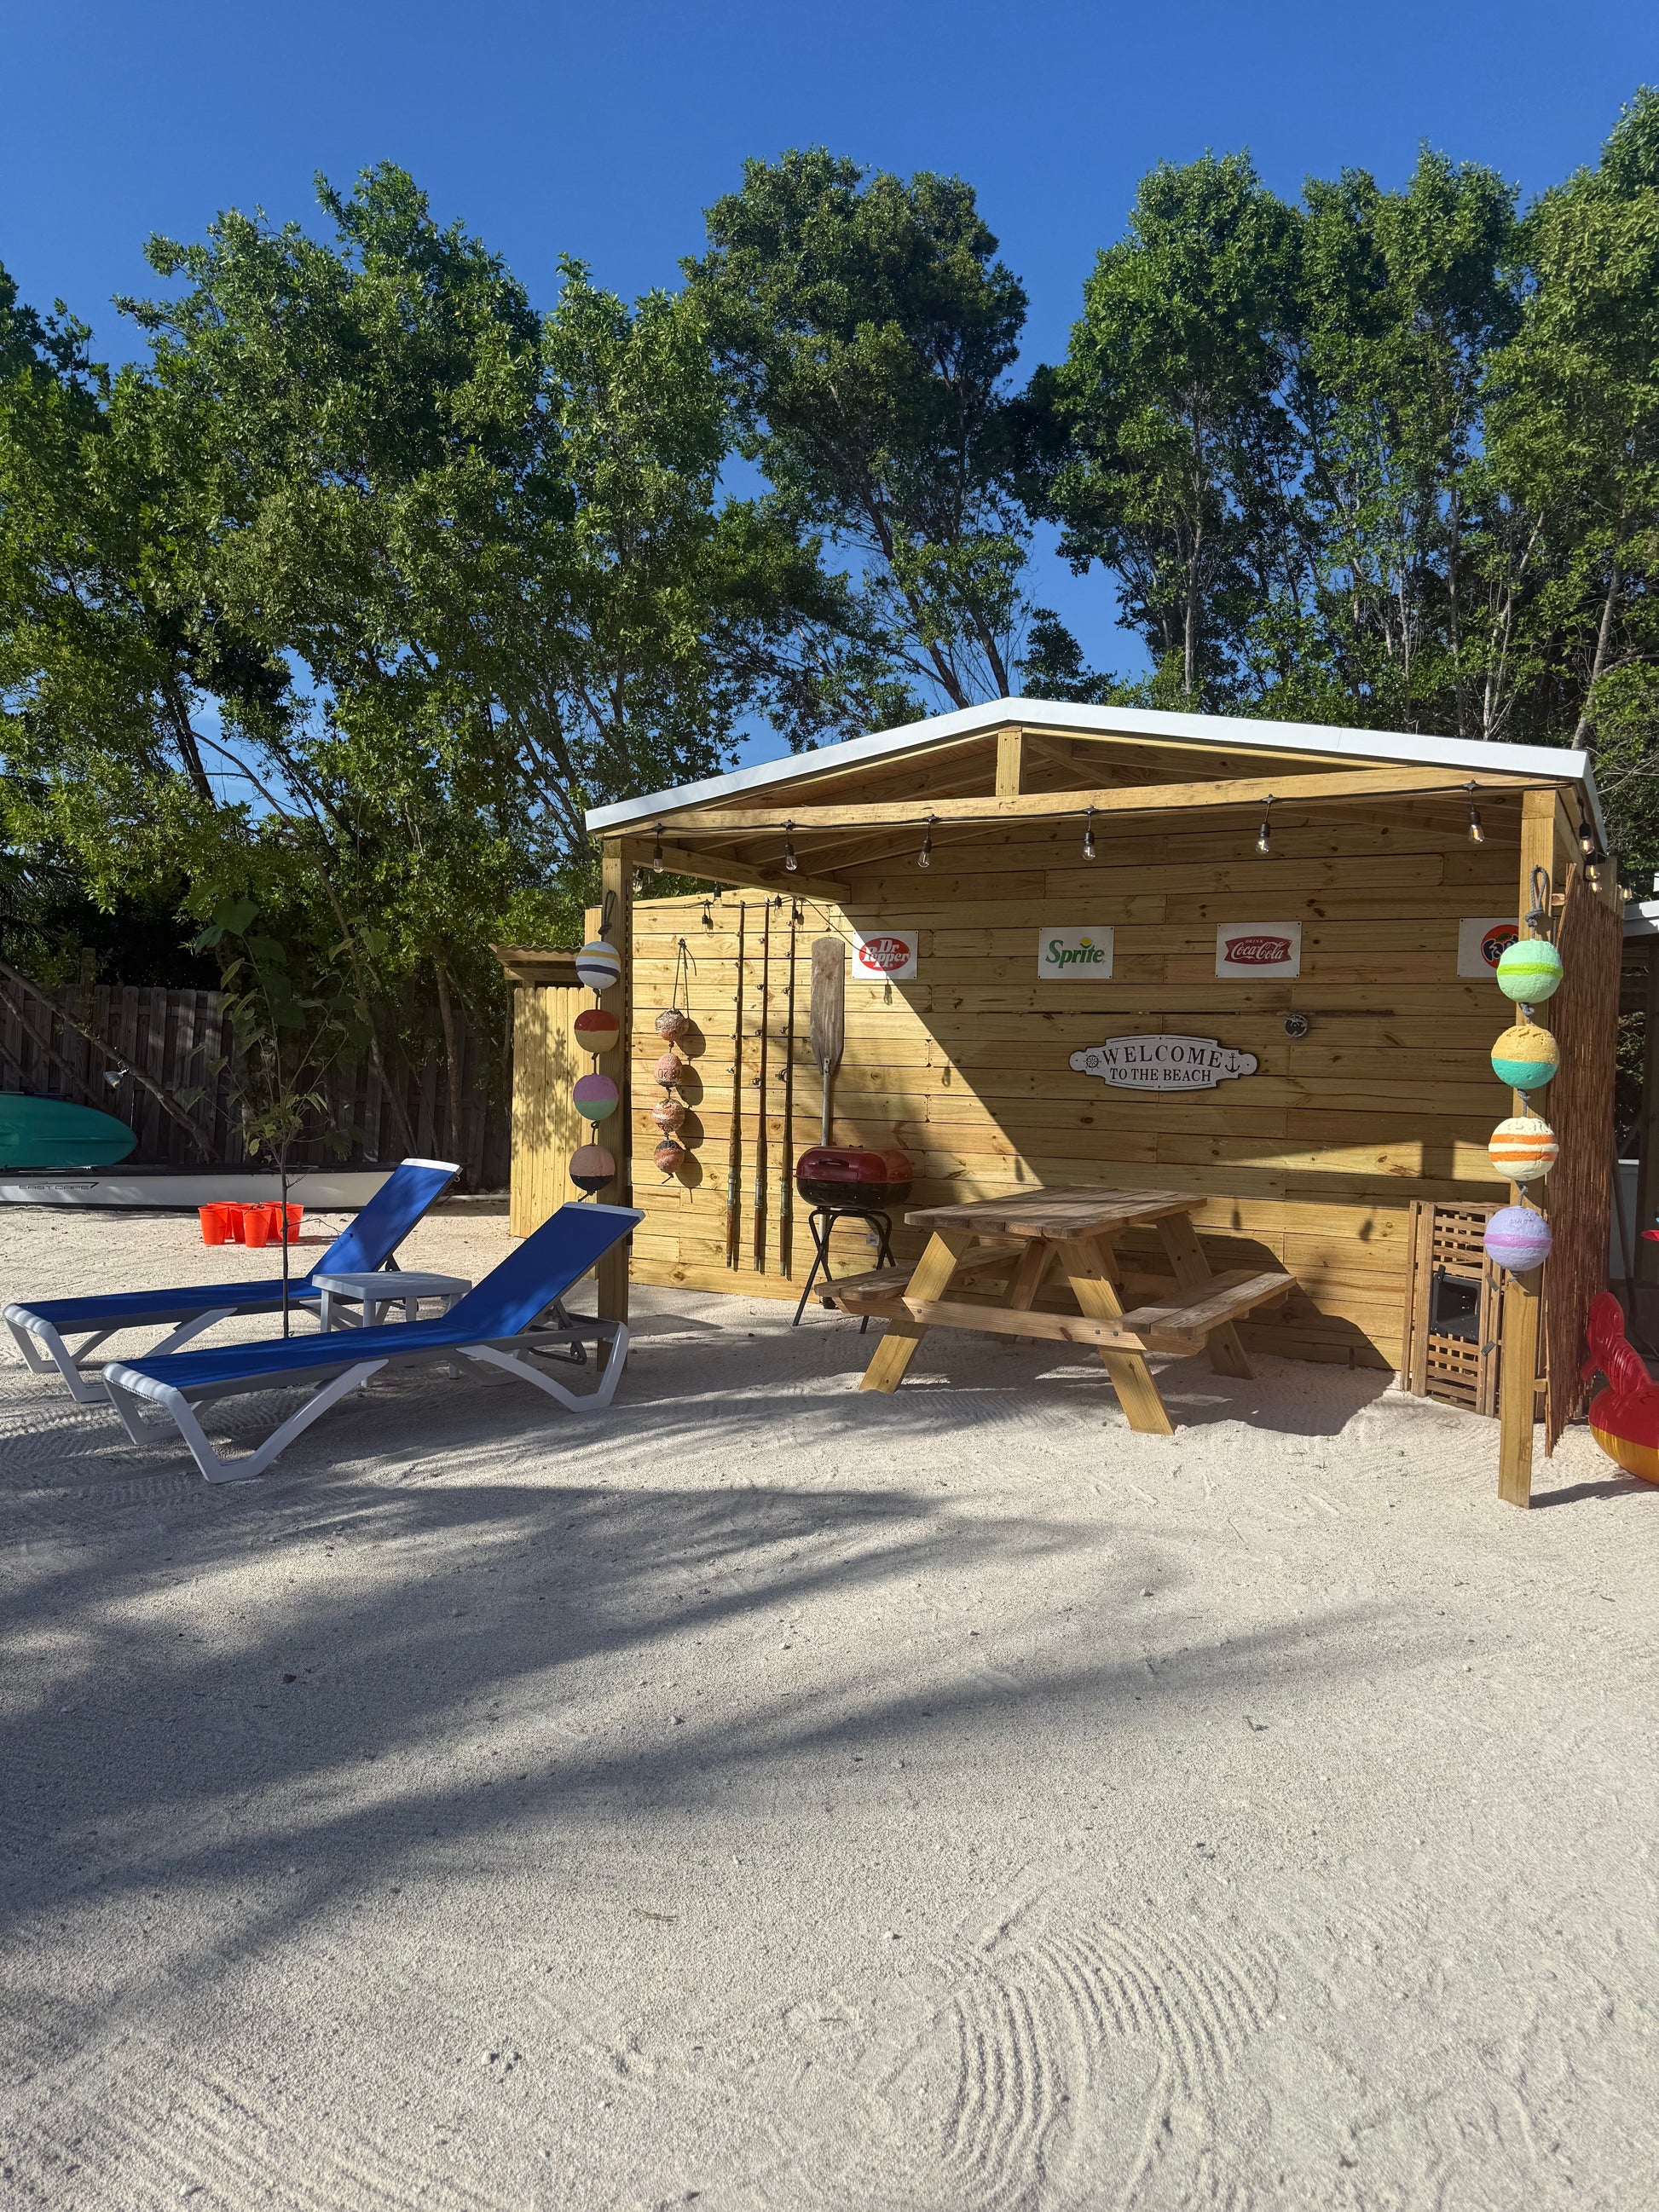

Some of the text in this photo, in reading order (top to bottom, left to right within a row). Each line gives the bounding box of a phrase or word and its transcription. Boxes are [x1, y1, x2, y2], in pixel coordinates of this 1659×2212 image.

[862, 946, 910, 967] Pepper
[878, 939, 899, 953] Dr
[1045, 938, 1106, 968] Sprite
[1102, 1045, 1223, 1068] WELCOME
[1110, 1068, 1211, 1082] TO THE BEACH
